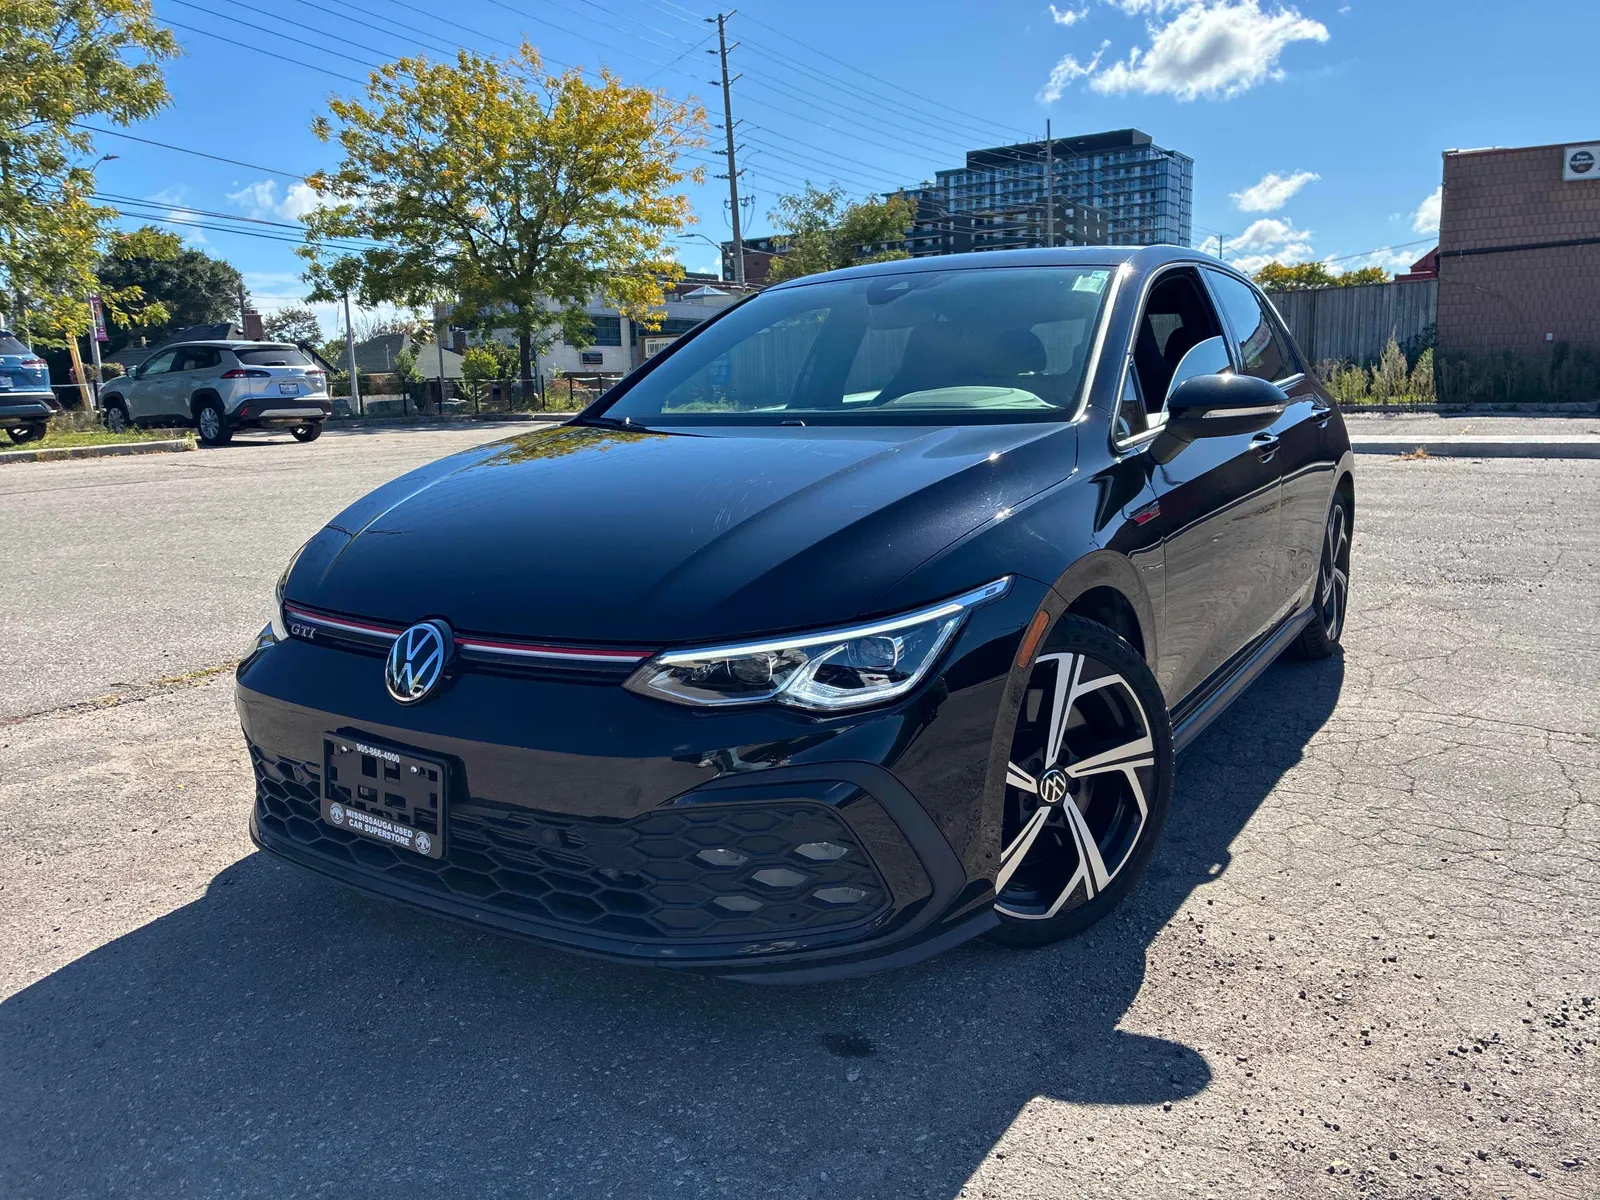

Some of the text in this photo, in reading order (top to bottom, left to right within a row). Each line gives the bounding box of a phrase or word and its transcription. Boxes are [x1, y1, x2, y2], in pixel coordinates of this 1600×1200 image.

[290, 623, 316, 640] GTI
[345, 808, 413, 838] MISSISSAUGA USED
[348, 818, 410, 847] CAR SUPERSTORE
